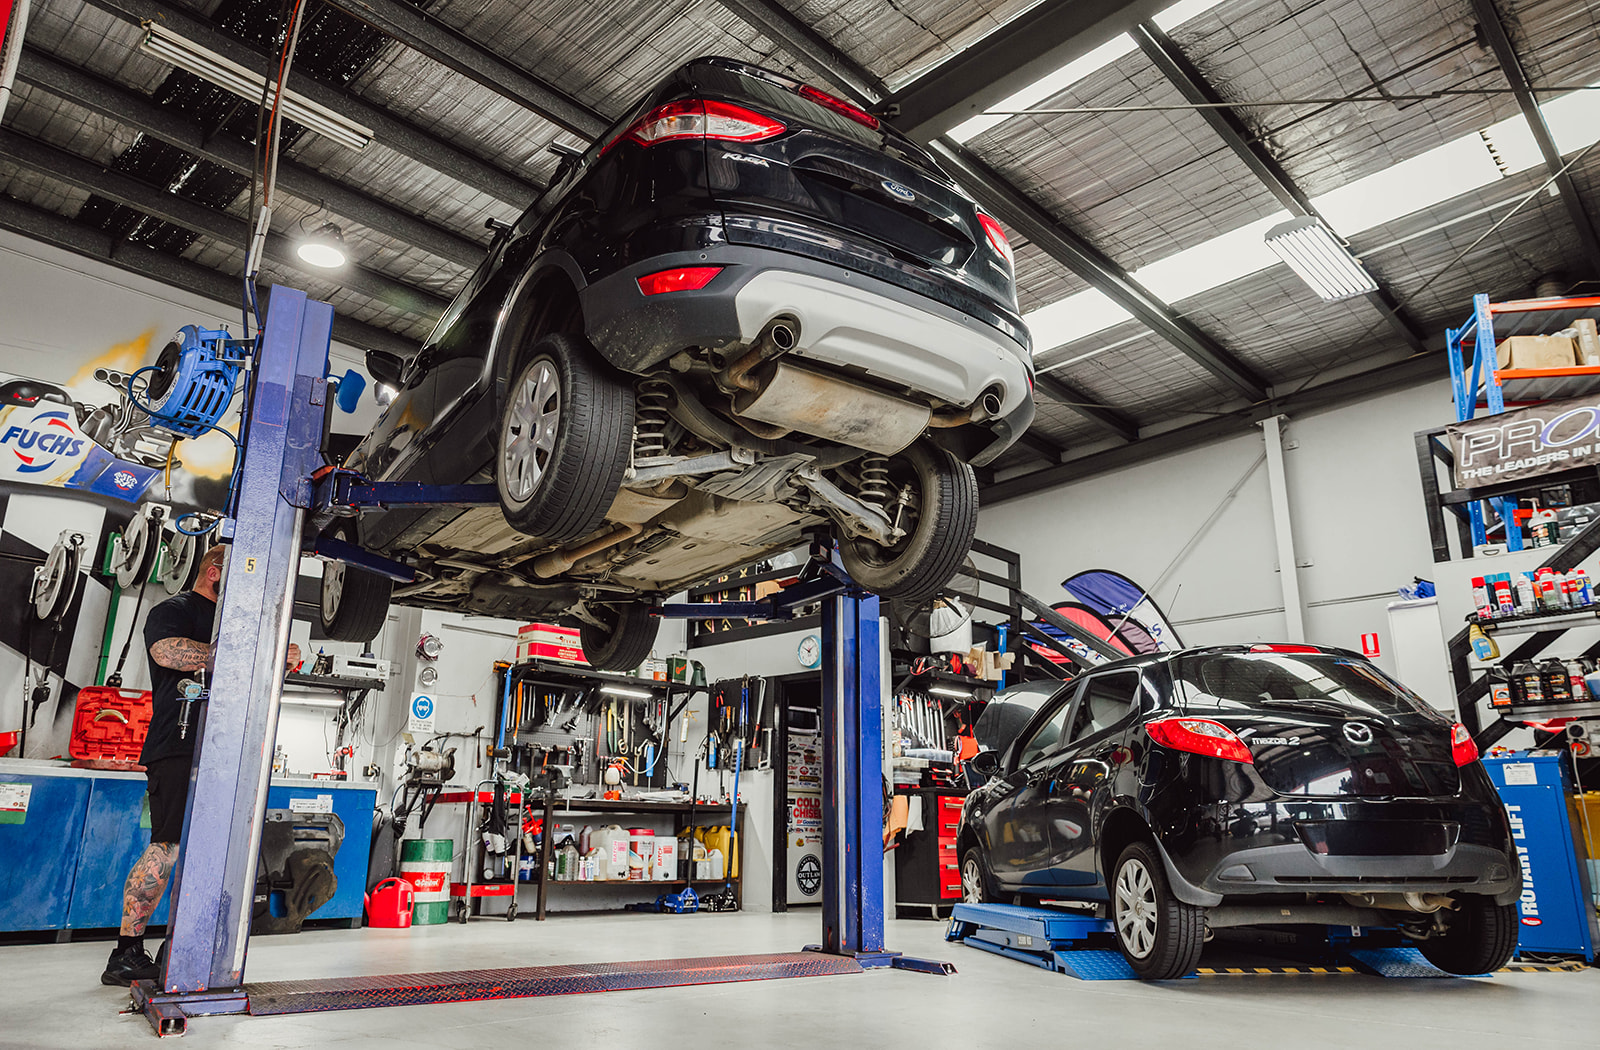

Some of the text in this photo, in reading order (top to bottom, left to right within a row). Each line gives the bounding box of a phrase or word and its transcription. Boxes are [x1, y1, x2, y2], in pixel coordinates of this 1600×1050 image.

[0, 425, 85, 457] FUCHS
[1461, 405, 1600, 467] PRO
[1461, 466, 1493, 479] THE
[1495, 450, 1570, 474] LEADERS
[1572, 445, 1592, 458] IN
[247, 559, 255, 572] 5
[793, 807, 822, 819] CHISEL
[796, 797, 821, 808] COLD
[1504, 803, 1526, 840] LIFT
